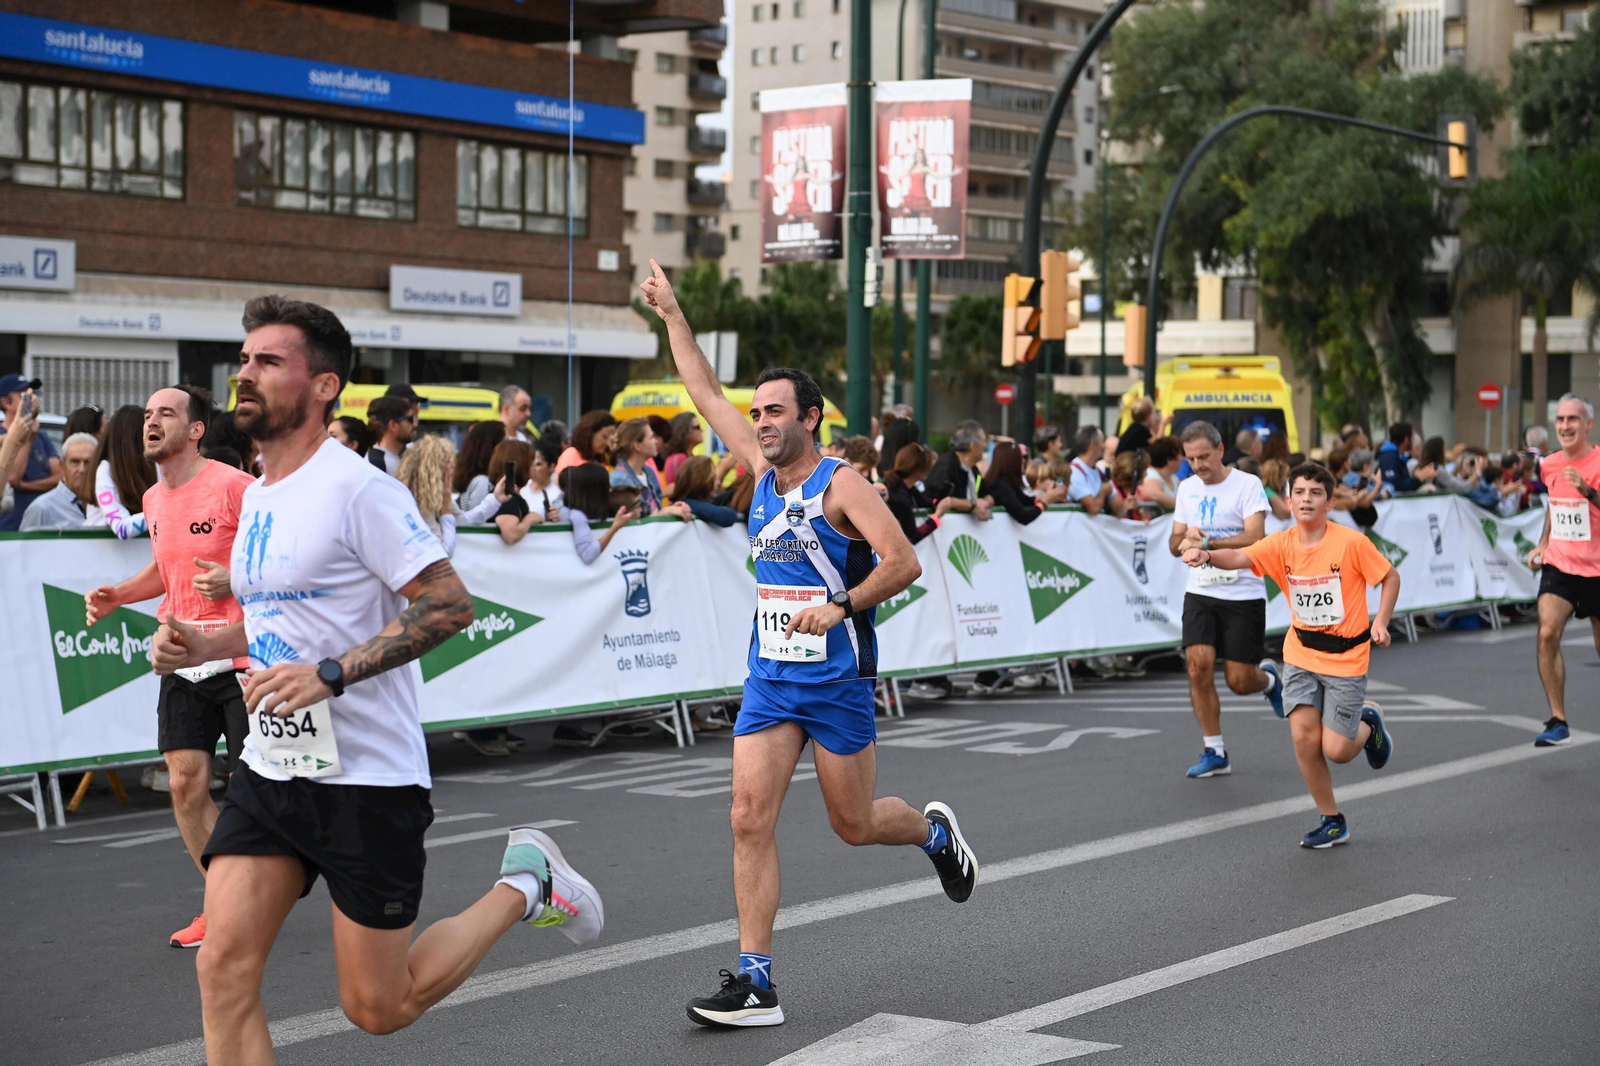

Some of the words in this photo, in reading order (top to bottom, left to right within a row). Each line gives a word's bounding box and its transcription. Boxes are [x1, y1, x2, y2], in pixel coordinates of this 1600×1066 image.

[0, 261, 25, 276] ank
[403, 287, 456, 305] Deutsche
[459, 290, 487, 306] Bank
[1184, 393, 1273, 403] AMBULANCIA
[1556, 513, 1582, 525] 1216
[189, 521, 213, 535] GO
[765, 538, 819, 551] DEPORTIVO
[769, 588, 797, 596] CARRERA
[1296, 591, 1334, 607] 3726
[957, 601, 1000, 616] Fundación
[762, 611, 800, 633] 119
[966, 622, 999, 637] Unicaja
[54, 629, 77, 659] El
[75, 630, 121, 658] Corte
[603, 629, 681, 652] Ayuntamiento
[617, 656, 632, 671] de
[634, 652, 678, 669] Málaga
[259, 710, 317, 738] 6554
